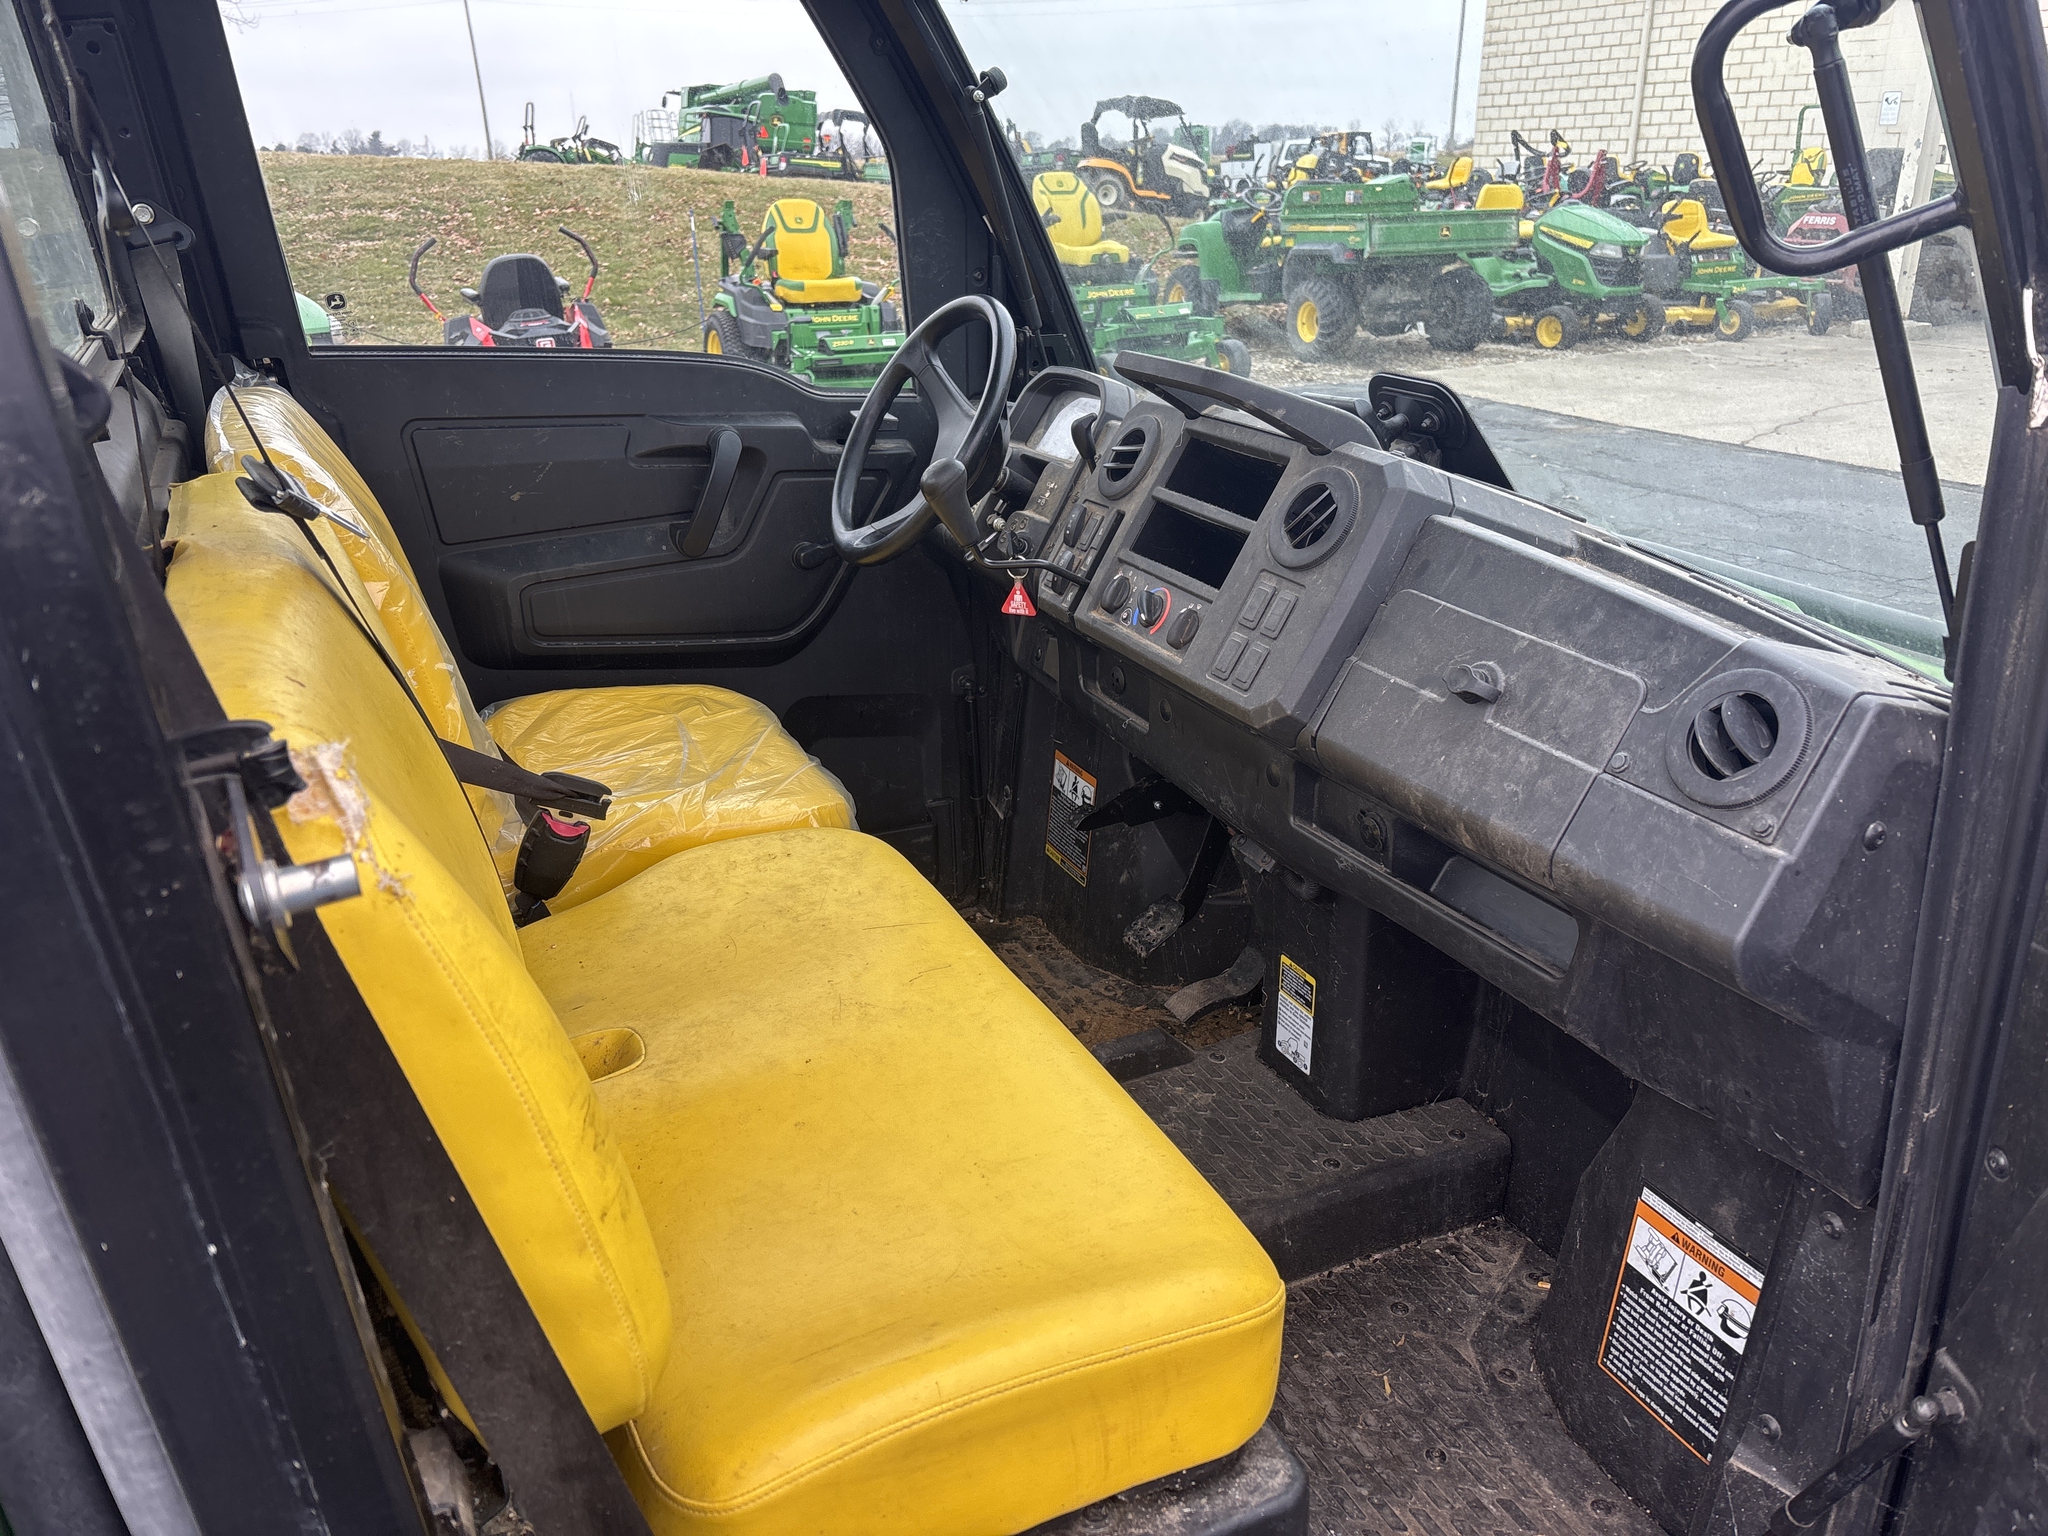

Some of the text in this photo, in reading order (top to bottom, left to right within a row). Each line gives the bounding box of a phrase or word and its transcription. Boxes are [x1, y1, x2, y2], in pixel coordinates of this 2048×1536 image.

[1803, 216, 1837, 225] FERRIS
[1696, 265, 1737, 275] JOHN DEERE
[1087, 288, 1136, 299] JOHN DEERE
[832, 314, 859, 322] DEERE
[1010, 600, 1027, 609] SAFETY
[1681, 1237, 1725, 1277] WARNING
[1639, 1287, 1654, 1303] From
[1655, 1300, 1680, 1324] Rollover
[1680, 1323, 1688, 1331] or
[1688, 1328, 1711, 1351] Falling
[1650, 1287, 1713, 1342] Avoid Injury or Death
